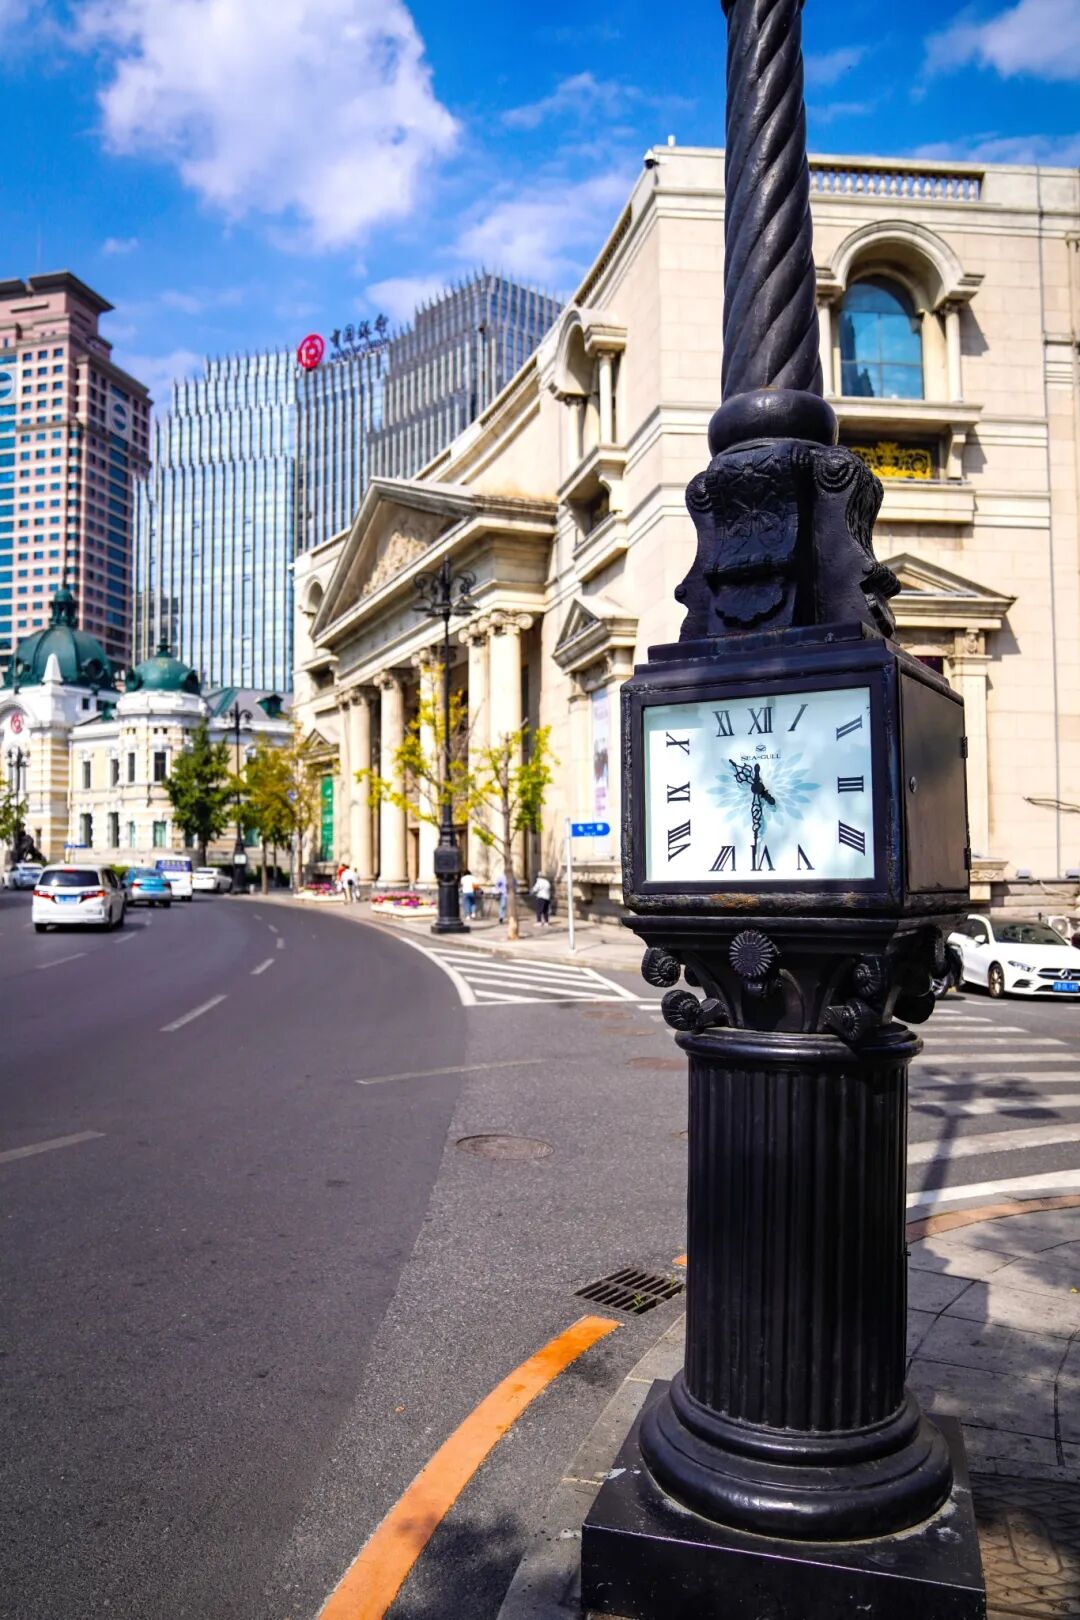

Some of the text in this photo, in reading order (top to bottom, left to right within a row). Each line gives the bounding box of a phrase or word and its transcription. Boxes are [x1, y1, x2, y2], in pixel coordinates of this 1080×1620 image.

[712, 710, 735, 737] XI
[747, 706, 773, 735] XII
[836, 714, 862, 741] II
[666, 731, 690, 755] X
[740, 753, 781, 761] SEA-GULL
[667, 781, 691, 804] IX
[838, 775, 864, 794] III
[668, 819, 691, 862] VIII
[838, 819, 866, 856] IIII
[708, 845, 737, 872] VII
[797, 843, 816, 871] V
